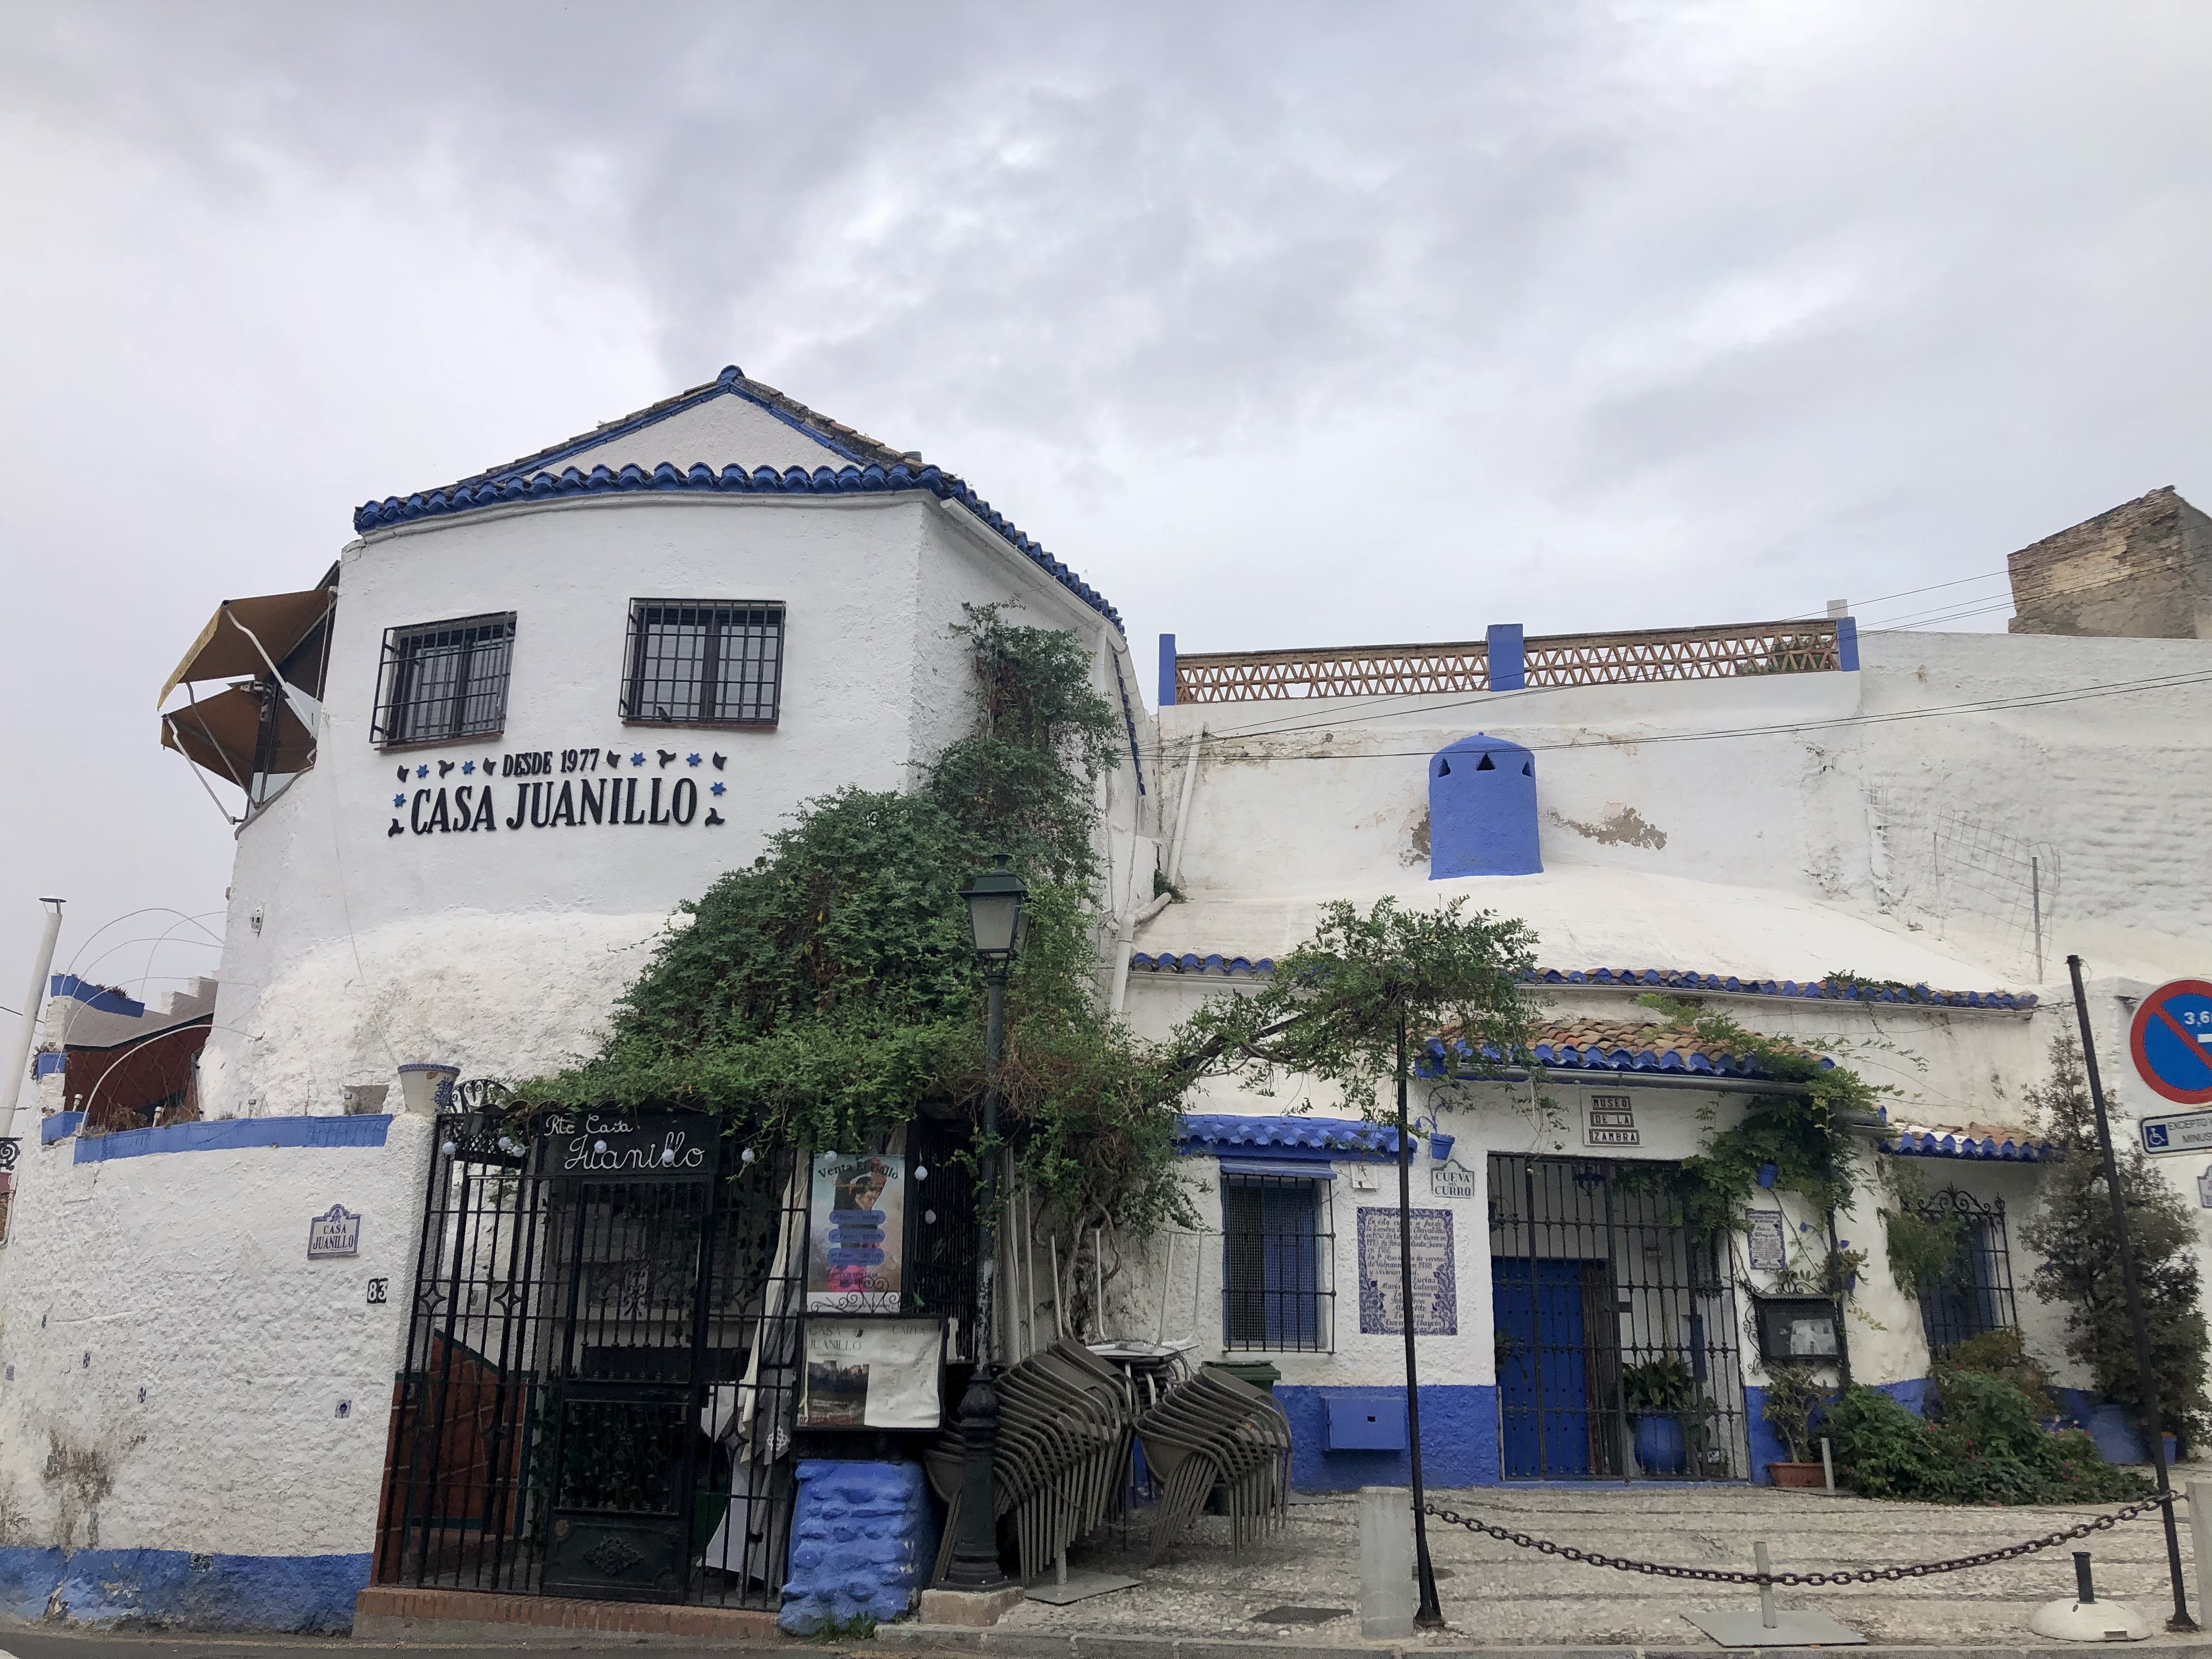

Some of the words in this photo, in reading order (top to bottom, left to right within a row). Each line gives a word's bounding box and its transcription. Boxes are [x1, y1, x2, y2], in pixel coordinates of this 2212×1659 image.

[502, 752, 552, 777] DESDE
[560, 748, 600, 773] 1977
[410, 785, 496, 835] CASA
[506, 777, 697, 830] JUANILLO
[1593, 1099, 1627, 1107] MUSEO
[586, 1114, 633, 1133] Casa
[1595, 1115, 1607, 1124] DE
[1617, 1115, 1629, 1124] LA
[2168, 1118, 2207, 1131] EXCEPTO
[1594, 1132, 1635, 1141] ZAMBRA
[565, 1131, 705, 1169] Juanillo
[817, 1163, 853, 1178] Venta
[1435, 1172, 1470, 1182] CUEVA
[1435, 1186, 1471, 1196] CURRO
[323, 1224, 347, 1234] CASA
[313, 1235, 354, 1250] JUANILLO
[368, 1281, 388, 1301] 83
[809, 1339, 861, 1351] JUANILLO
